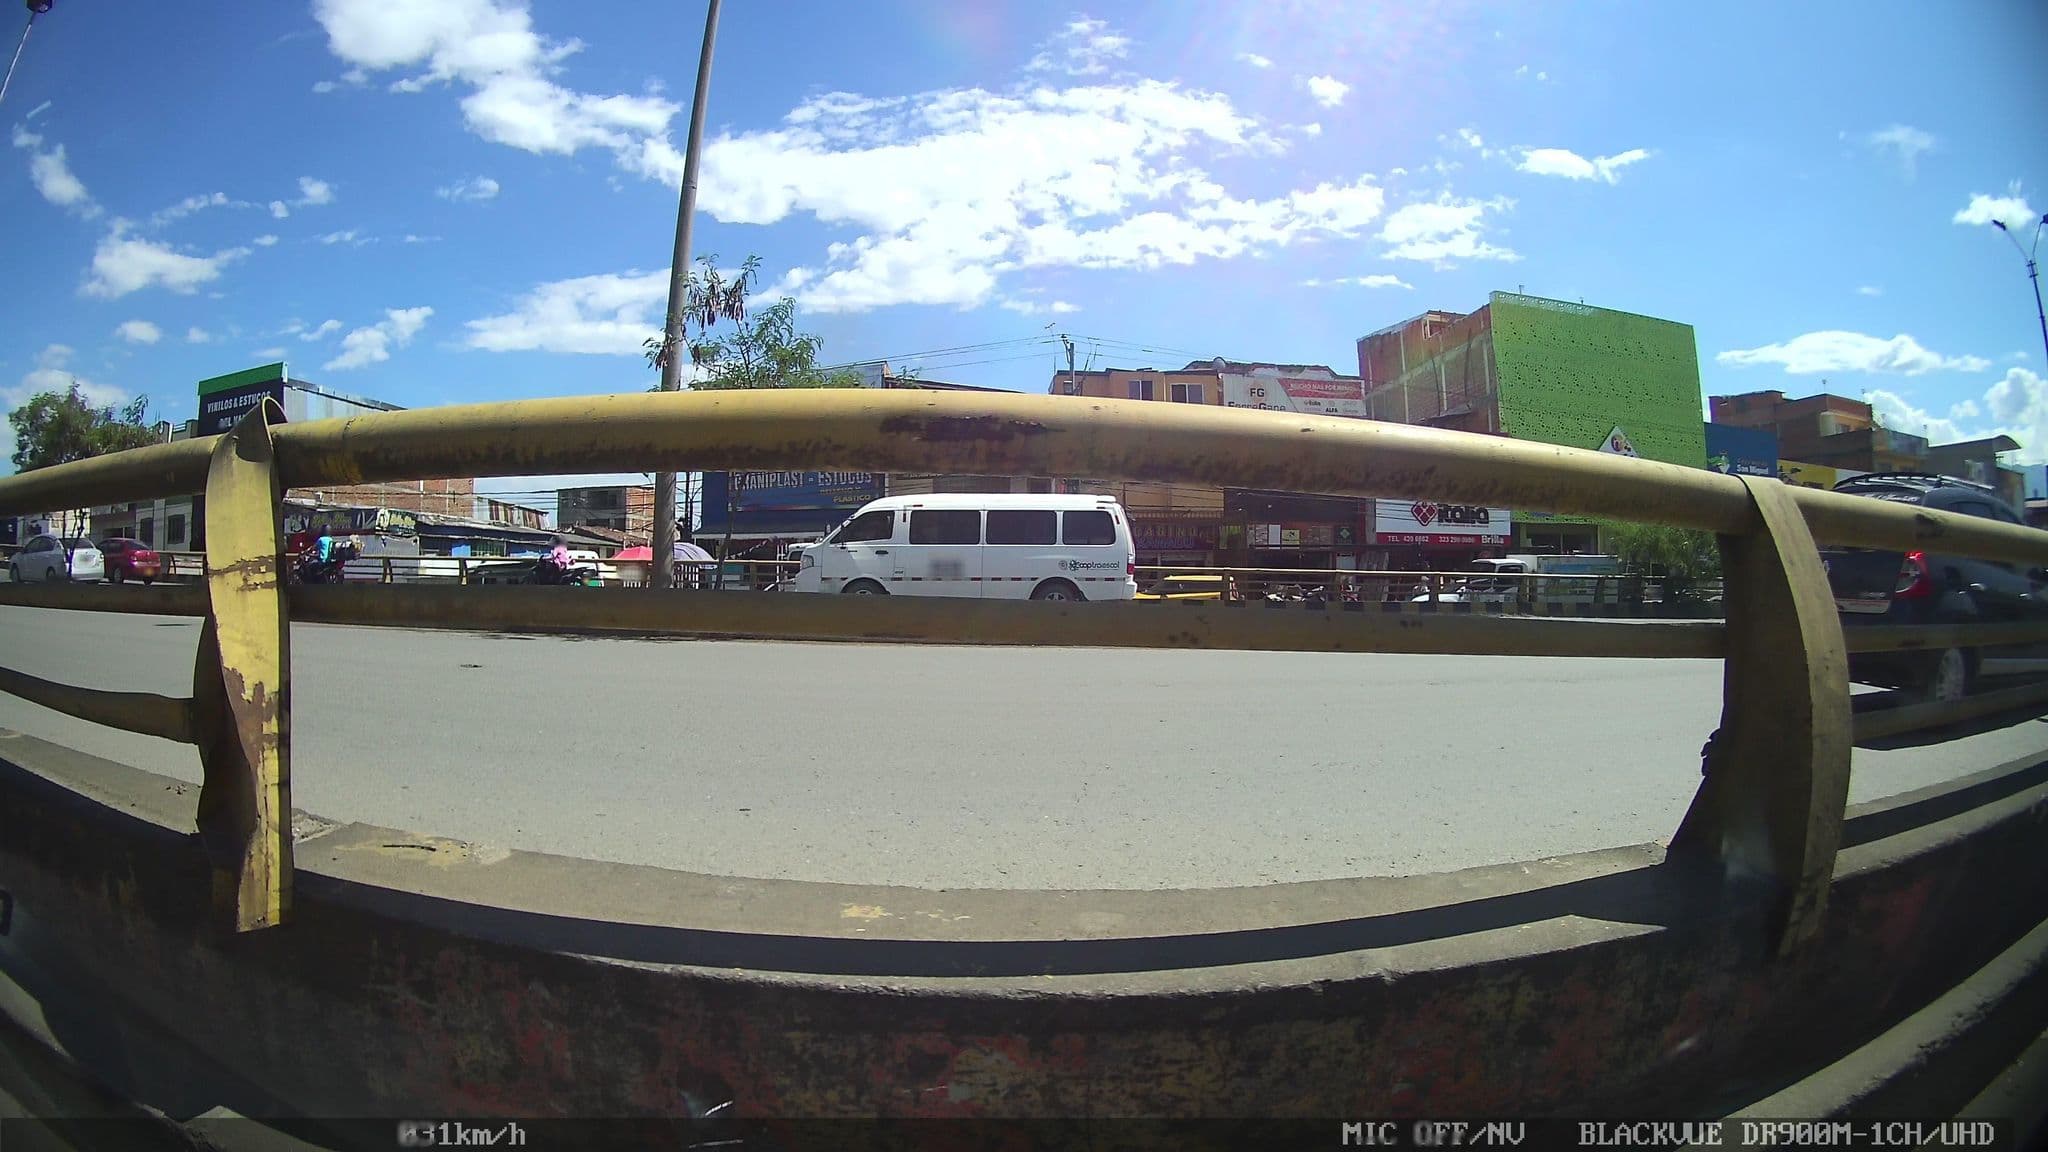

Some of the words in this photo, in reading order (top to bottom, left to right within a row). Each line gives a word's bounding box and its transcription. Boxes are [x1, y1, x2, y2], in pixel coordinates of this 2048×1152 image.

[1249, 387, 1265, 397] FG
[207, 398, 233, 413] VINILOS
[1388, 535, 1400, 543] TEL
